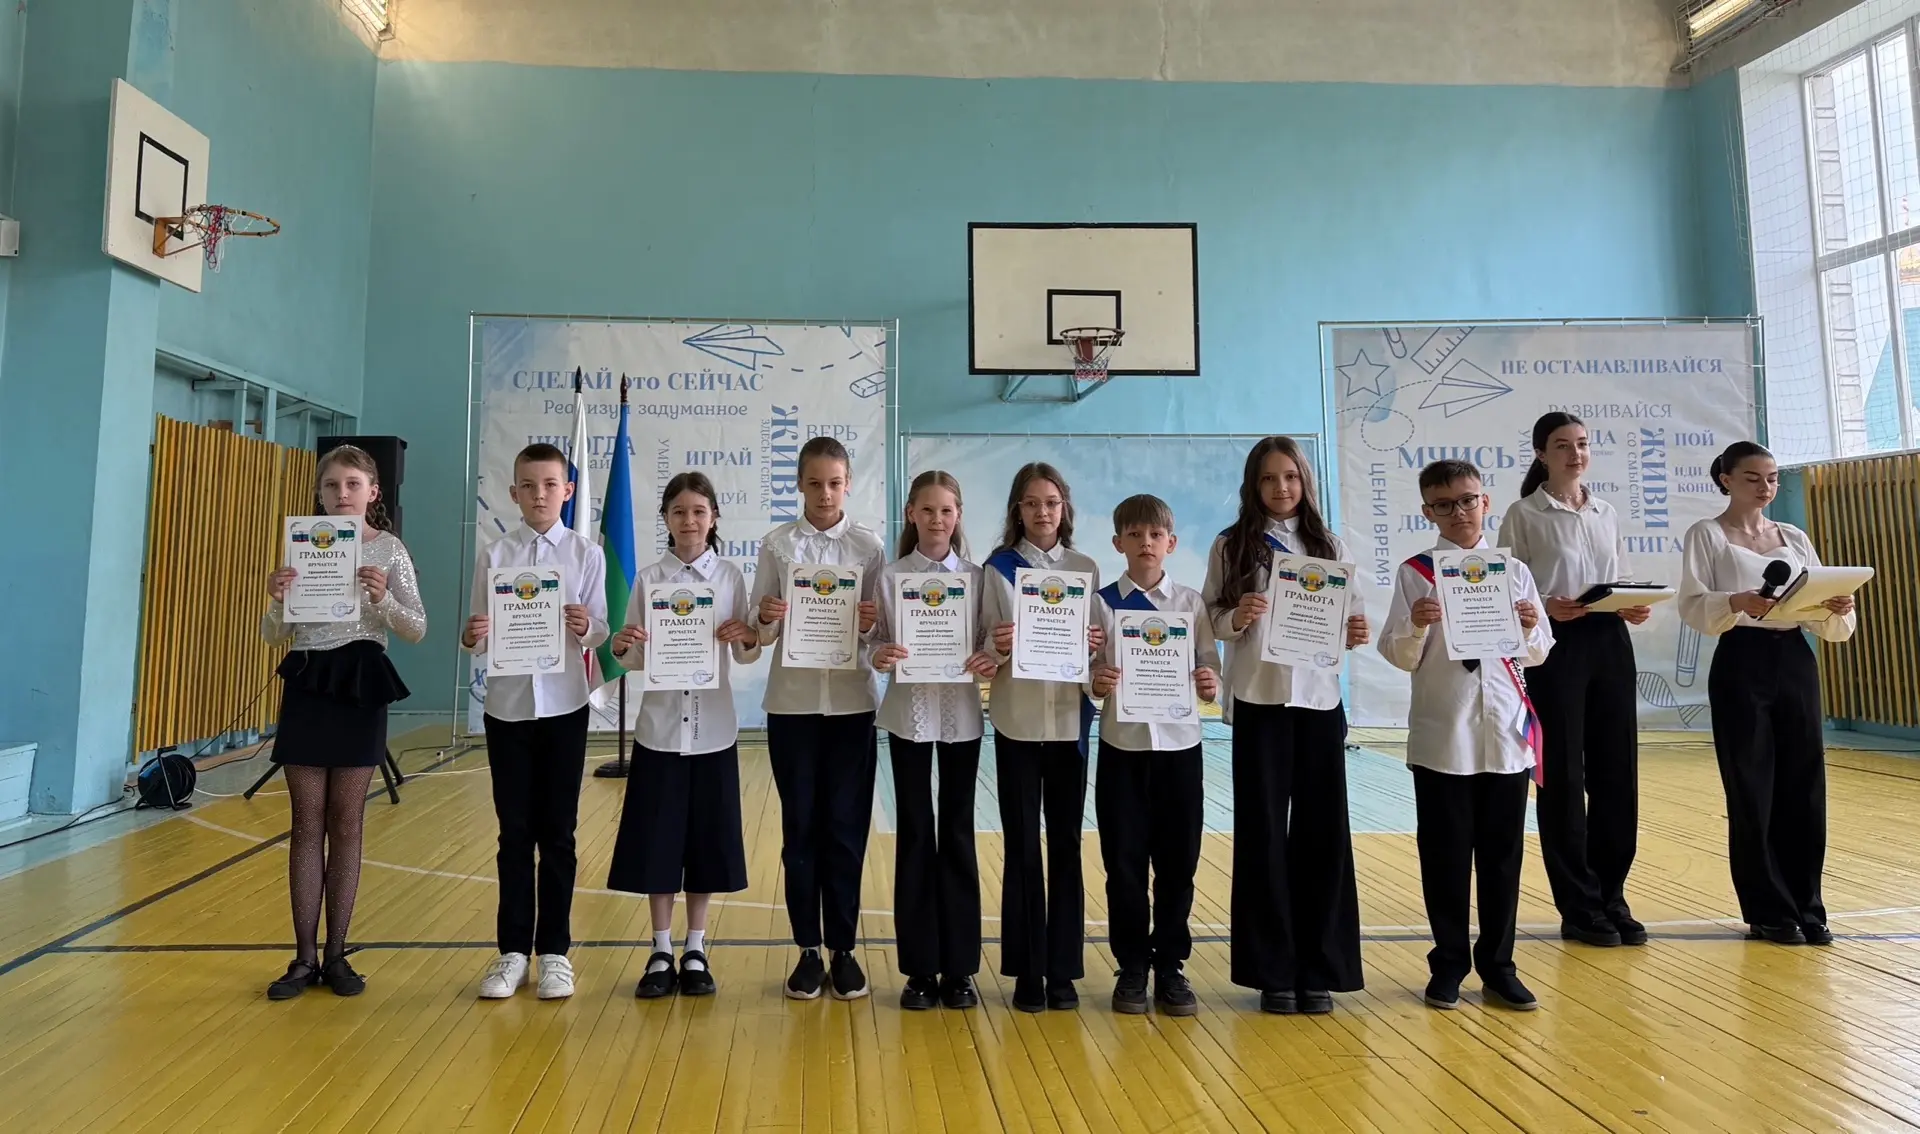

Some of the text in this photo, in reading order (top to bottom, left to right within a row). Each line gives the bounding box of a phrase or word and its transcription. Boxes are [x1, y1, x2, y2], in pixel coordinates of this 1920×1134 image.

[1501, 356, 1723, 375] НЕ ОСТАНАВЛИВАЙСЯ
[512, 367, 612, 393] СДЕЛАЙ
[667, 367, 764, 392] СЕЙЧАС
[543, 399, 748, 419] Реаизу задуманное
[760, 419, 770, 454] ЗДЕСЬ
[806, 424, 858, 441] ВЕРЬ
[1674, 430, 1715, 446] ПОЙ
[686, 448, 752, 466] ИГРАЙ
[770, 403, 799, 524] ЖИВИ
[1640, 426, 1669, 529] ЖИВИ
[1678, 482, 1716, 494] КОНЦ
[1368, 462, 1390, 586] ЦЕНИ ВРЕМЯ
[300, 551, 346, 559] ГРАМОТА
[1452, 585, 1500, 594] ГРАМОТА
[504, 601, 550, 611] ГРАМОТА
[801, 597, 846, 606] ГРАМОТА
[1285, 590, 1335, 606] ГРАМОТА
[1029, 605, 1075, 616] ГРАМОТА
[1293, 604, 1324, 612] ВРУЧАЕТСЯ
[660, 618, 705, 626] ГРАМОТА
[1131, 648, 1179, 657] ГРАМОТА
